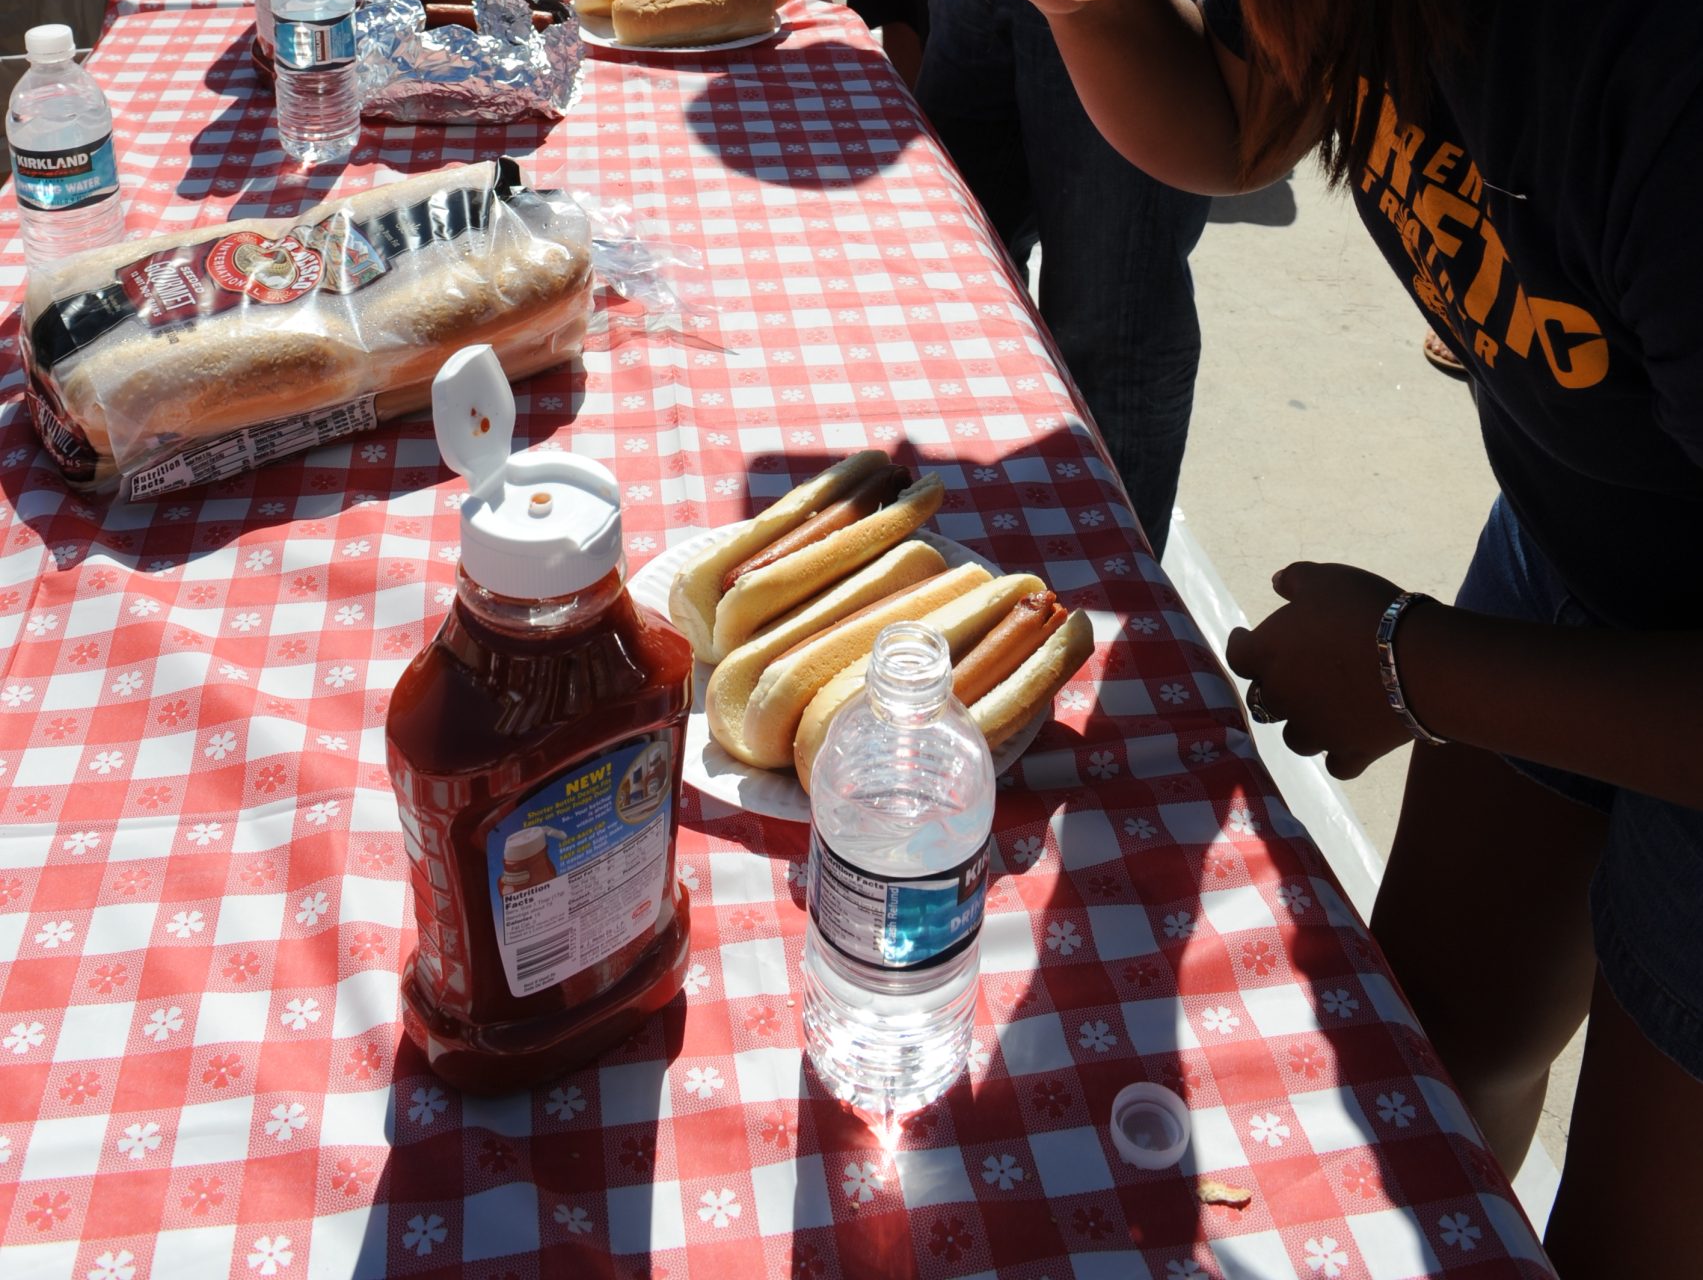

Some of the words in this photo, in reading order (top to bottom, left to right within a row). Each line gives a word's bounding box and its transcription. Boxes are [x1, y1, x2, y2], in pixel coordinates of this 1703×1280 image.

[16, 153, 89, 170] KIRKLAND
[65, 176, 101, 193] WATER
[180, 266, 205, 293] SEEDED
[213, 241, 260, 297] INTERNATIONL
[144, 261, 196, 311] GOURMET
[133, 459, 181, 485] Nutrition
[133, 477, 165, 494] Facts
[565, 762, 612, 796] NEW!
[505, 883, 551, 904] Nutrition
[856, 874, 885, 891] Facts
[505, 897, 534, 911] Facts
[887, 887, 900, 920] Refund
